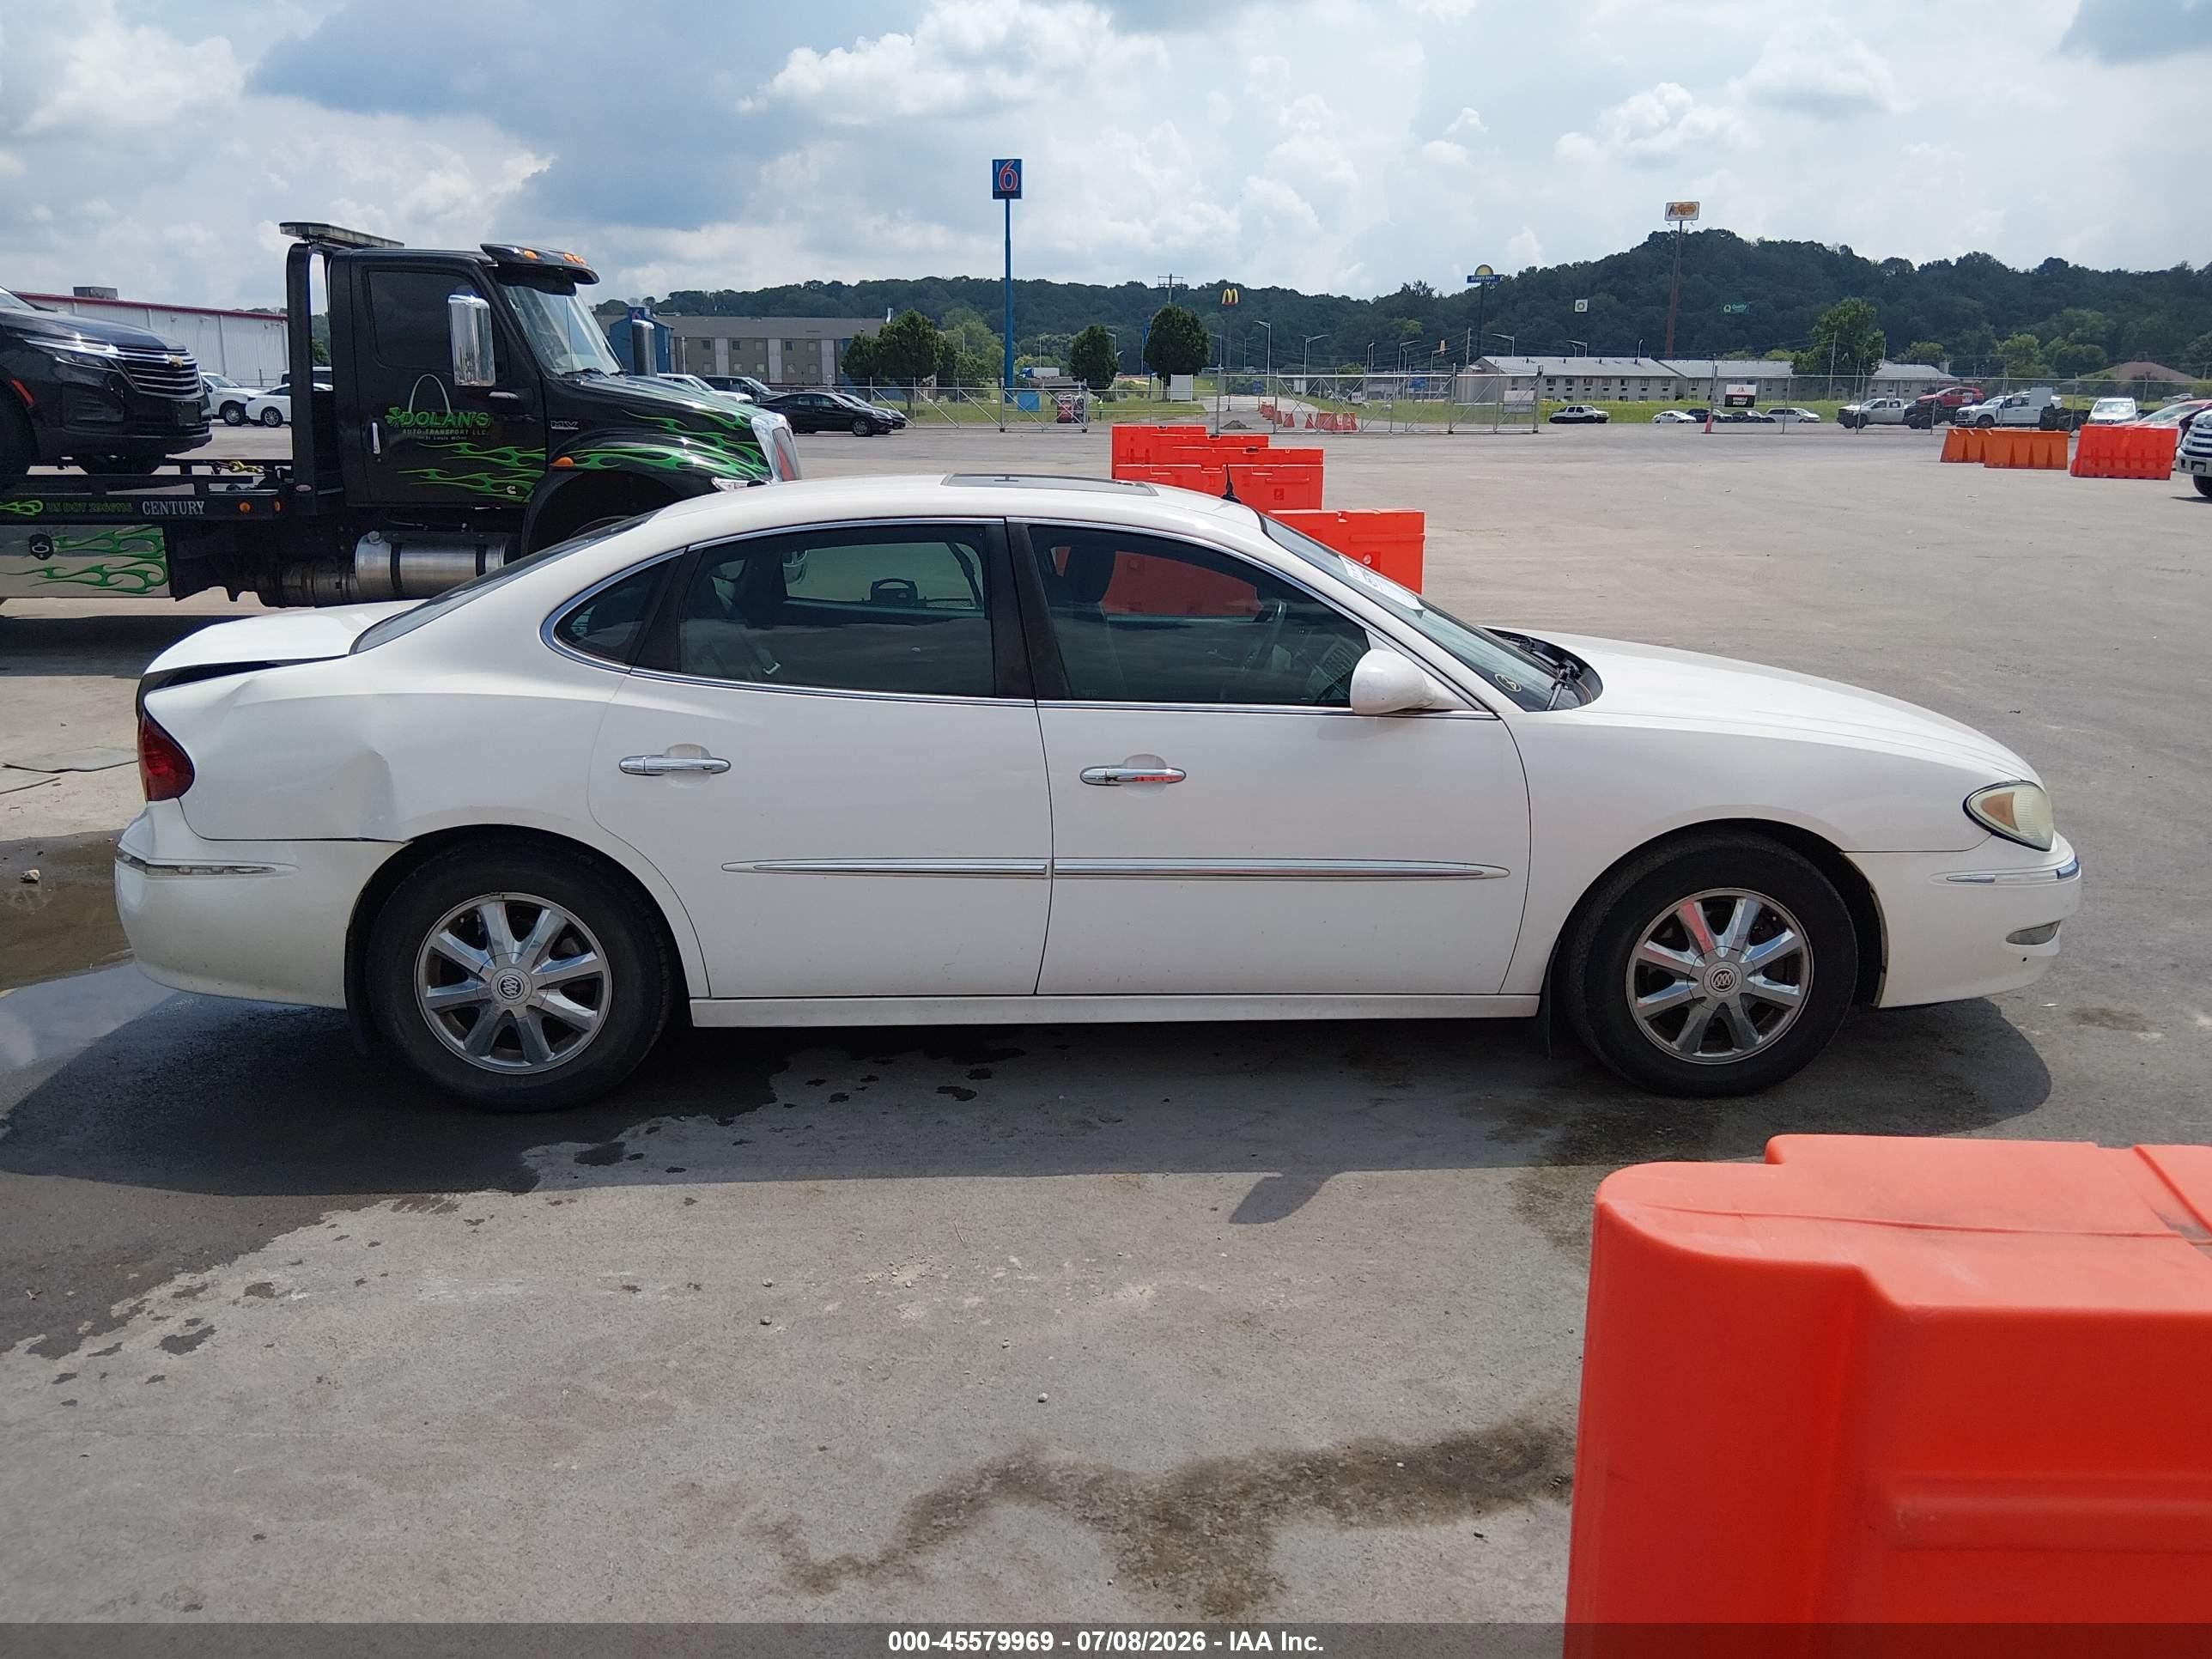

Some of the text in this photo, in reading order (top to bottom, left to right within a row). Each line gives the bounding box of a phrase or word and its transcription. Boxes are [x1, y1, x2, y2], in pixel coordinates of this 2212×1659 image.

[999, 160, 1018, 191] 6
[401, 411, 490, 427] DOLAN'S
[143, 501, 205, 515] CENTURY
